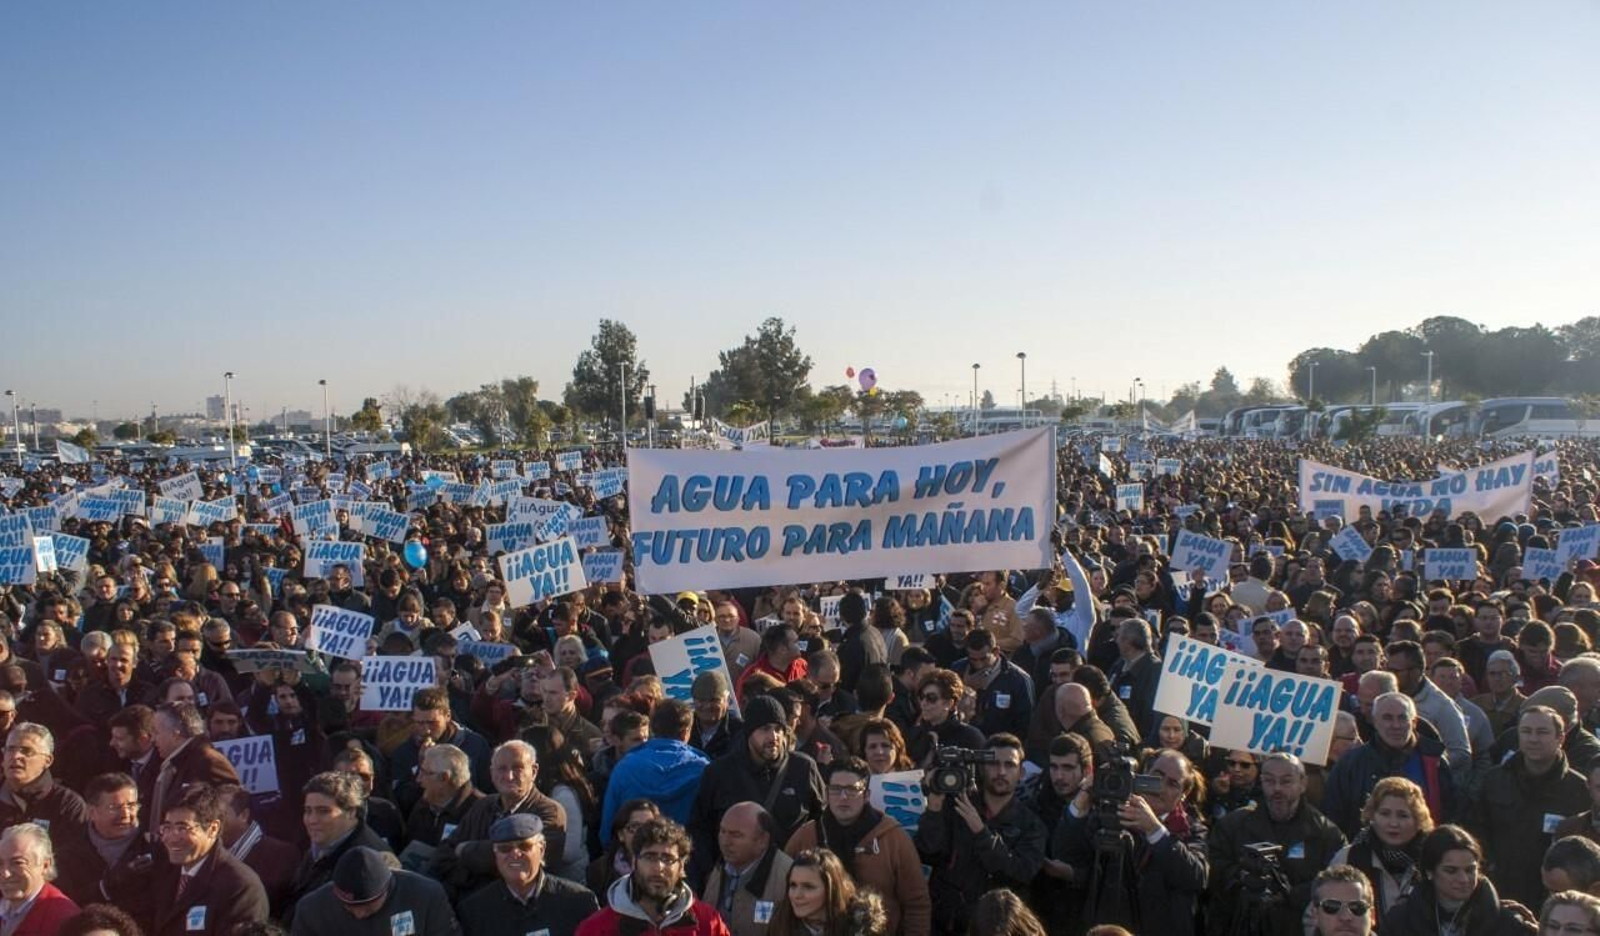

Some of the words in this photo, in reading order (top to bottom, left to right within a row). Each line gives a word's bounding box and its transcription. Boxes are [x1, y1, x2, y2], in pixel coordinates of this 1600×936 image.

[651, 474, 770, 513] AGUA
[786, 469, 900, 509] PARA
[913, 457, 1006, 499] HOY,
[1309, 471, 1352, 493] SIN
[1357, 478, 1423, 498] AGUA
[1430, 473, 1468, 497] NO
[1475, 463, 1526, 492] HAY
[489, 523, 533, 542] ¡¡AGUA
[632, 525, 770, 567] FUTURO
[782, 520, 872, 556] PARA
[882, 501, 1035, 549] MAÑANA
[308, 542, 361, 560] ¡¡AGUA
[506, 540, 574, 582] ¡¡AGUA
[529, 567, 570, 600] YA!!
[897, 574, 924, 588] YA!!
[312, 608, 372, 638] ¡¡AGUA
[318, 630, 354, 656] YA!!
[363, 661, 434, 684] ¡¡AGUA
[1168, 641, 1227, 685] ¡¡AG
[1185, 683, 1220, 722] YA
[1224, 669, 1335, 723] ¡¡AGUA
[1248, 712, 1315, 757] YA!!
[220, 739, 272, 768] GUA
